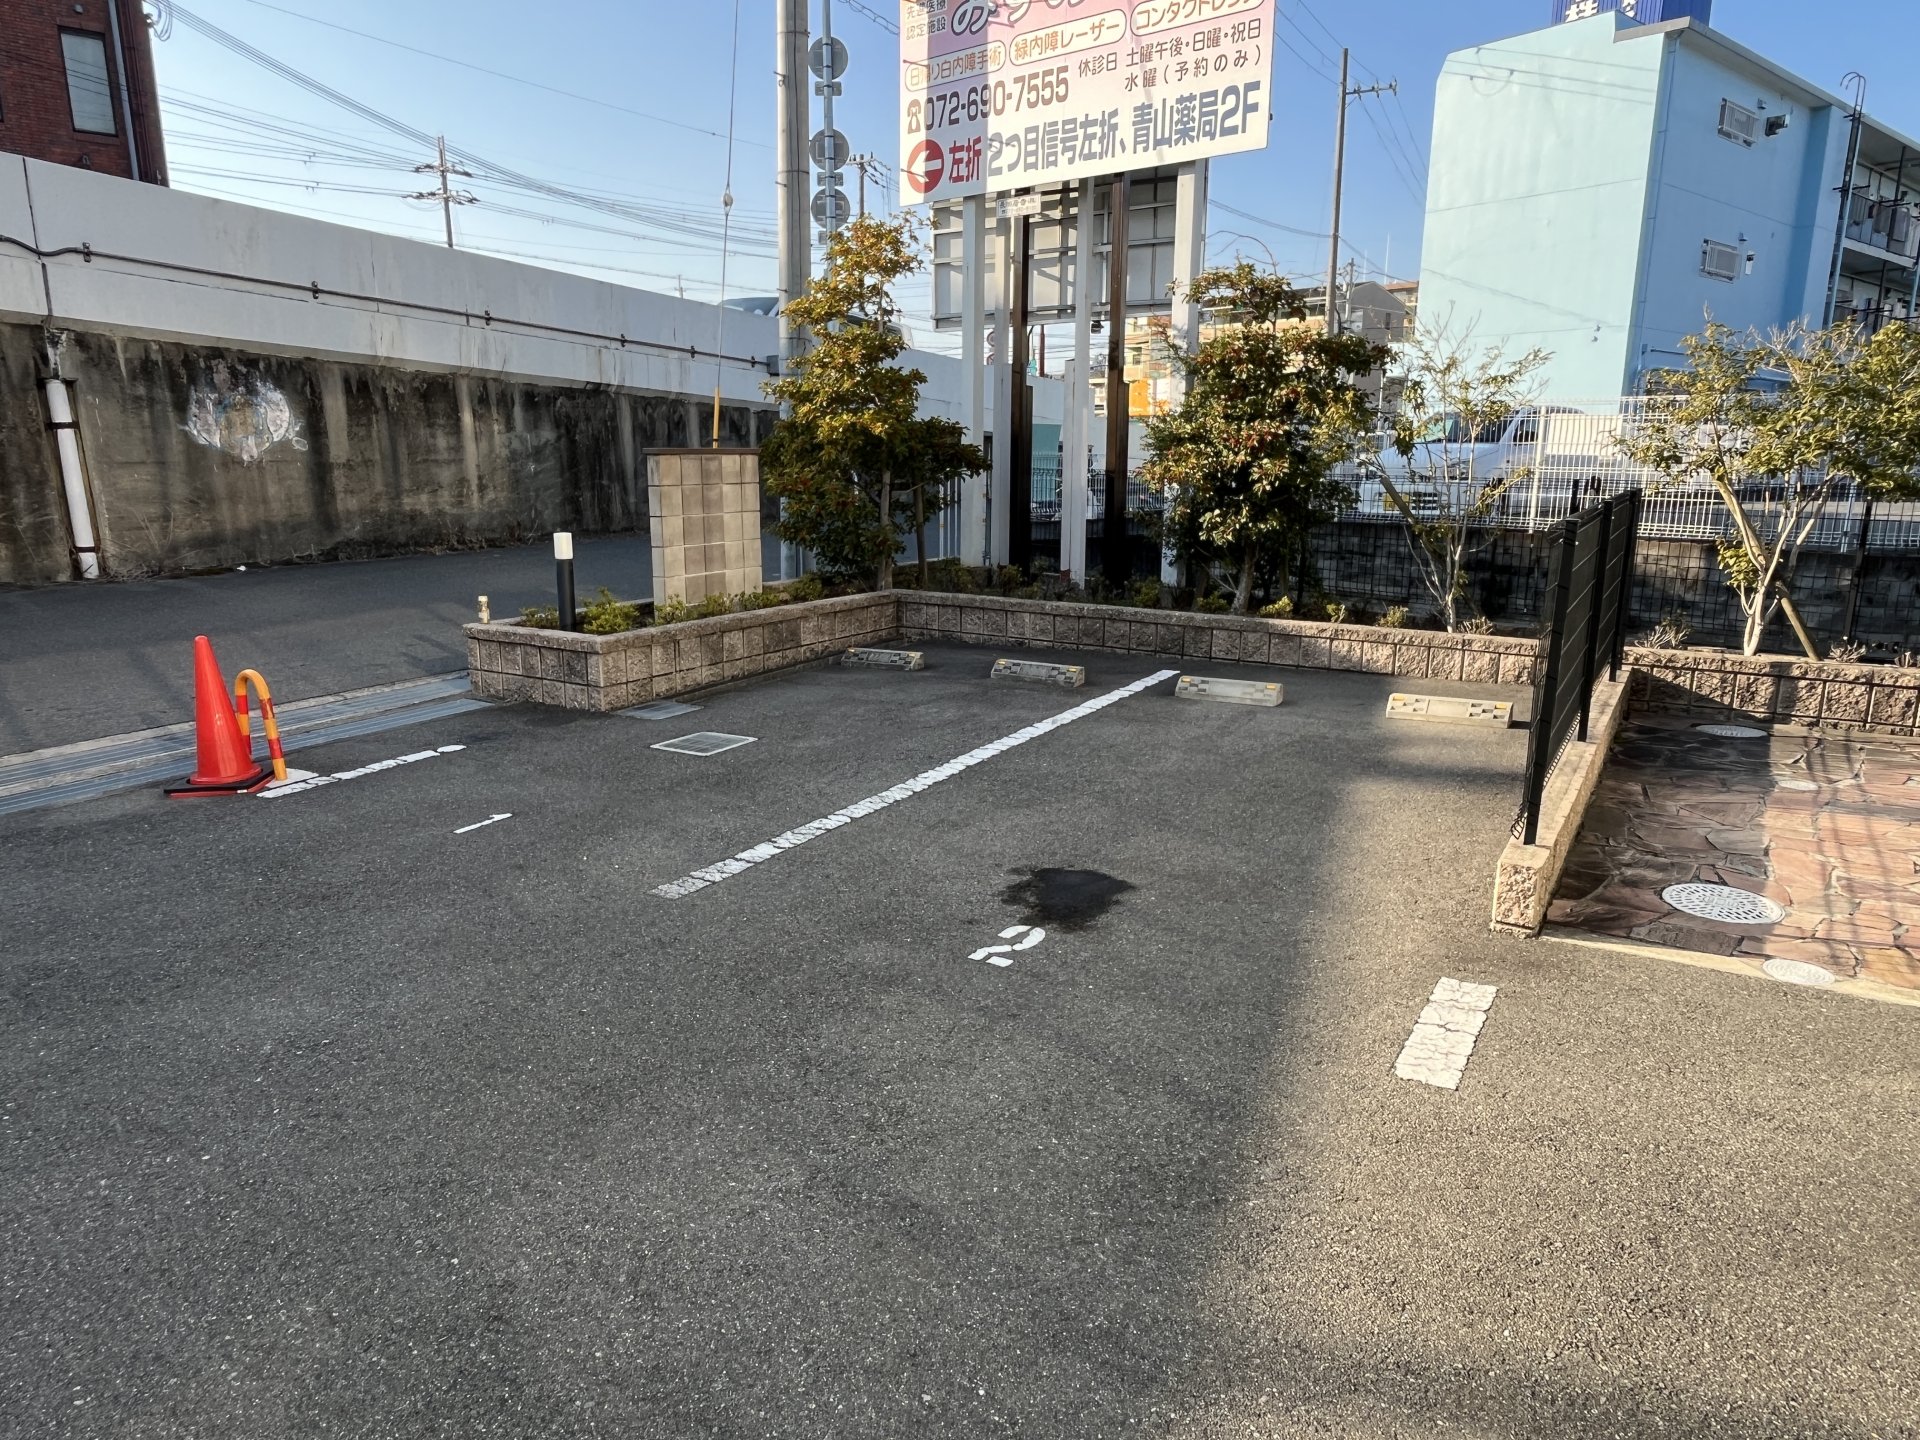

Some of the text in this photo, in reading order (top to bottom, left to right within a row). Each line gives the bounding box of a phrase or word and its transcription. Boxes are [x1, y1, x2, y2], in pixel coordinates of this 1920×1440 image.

[907, 16, 947, 41] 認定施設
[1014, 18, 1120, 61] 緑内障レーザー
[1078, 52, 1118, 78] 休診日
[1126, 18, 1261, 68] 土曜午後・日曜・祝日
[910, 45, 1002, 86] 日帰り白内障手術
[924, 66, 1069, 131] 072-690-7555
[948, 135, 982, 184] 左折
[967, 925, 1046, 968] 2
